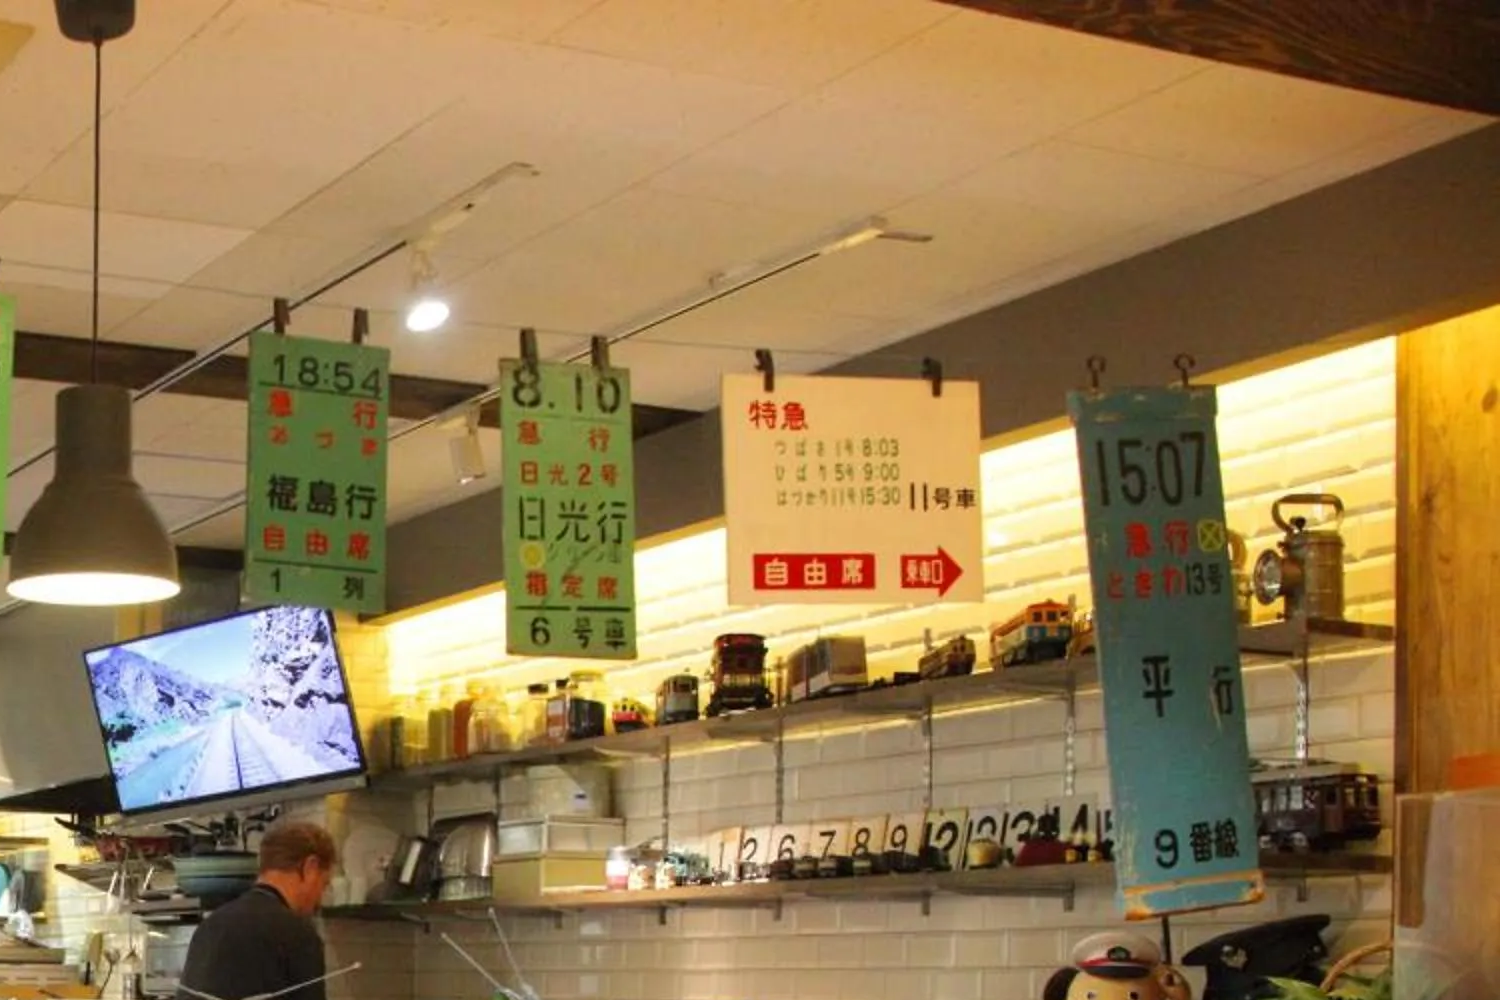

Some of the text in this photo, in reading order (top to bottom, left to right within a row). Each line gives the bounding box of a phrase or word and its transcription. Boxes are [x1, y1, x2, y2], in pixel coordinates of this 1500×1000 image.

[274, 354, 382, 398] 18:54
[267, 391, 378, 429] 急行
[749, 400, 808, 430] 特急
[518, 421, 610, 452] 急行
[520, 462, 619, 487] 日光2号
[267, 474, 377, 520] 福島行
[909, 483, 975, 511] 11号車
[518, 497, 627, 544] 日光行
[264, 525, 371, 560] 自由席
[1125, 520, 1189, 558] 急行
[526, 571, 619, 599] 指定席
[765, 558, 863, 585] 自由席
[530, 617, 626, 649] 6号車
[1155, 817, 1239, 869] 9番線
